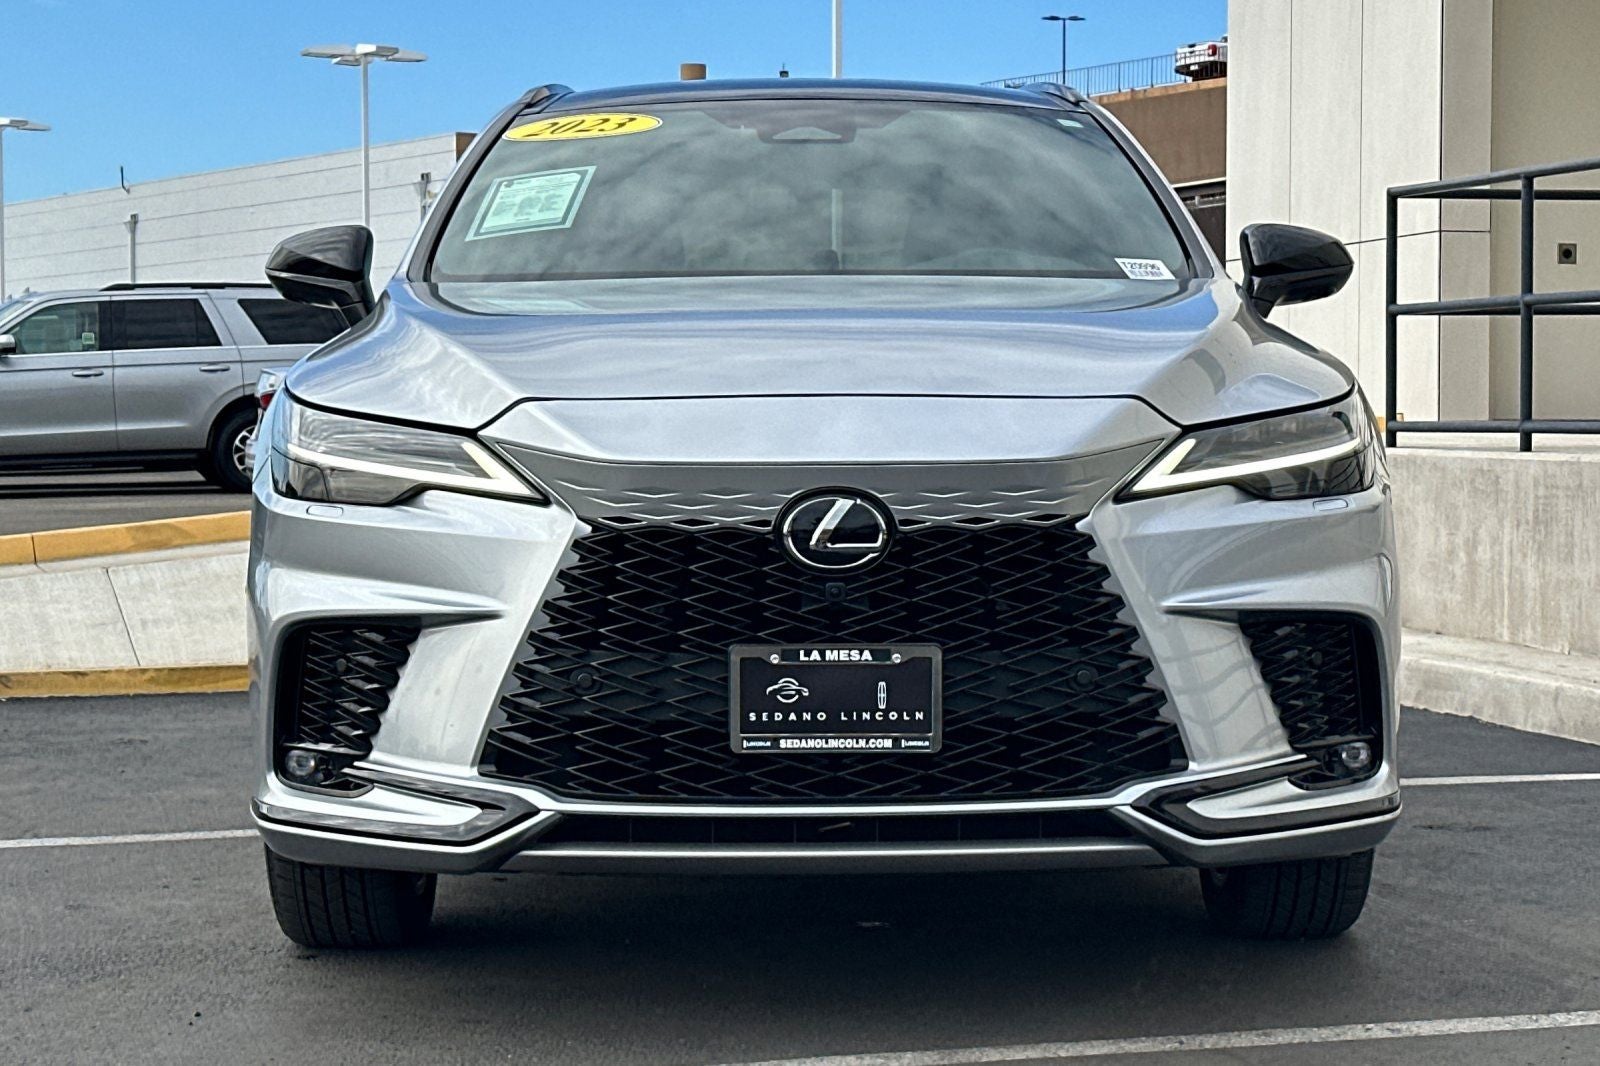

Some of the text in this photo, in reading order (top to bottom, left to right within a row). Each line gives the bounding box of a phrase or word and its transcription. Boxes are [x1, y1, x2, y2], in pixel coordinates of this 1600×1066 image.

[523, 117, 638, 138] 2023
[799, 649, 873, 661] LA MESA
[749, 711, 925, 721] SEDANO LINCOLN
[779, 738, 893, 749] SEDANOLINCOLN.COM
